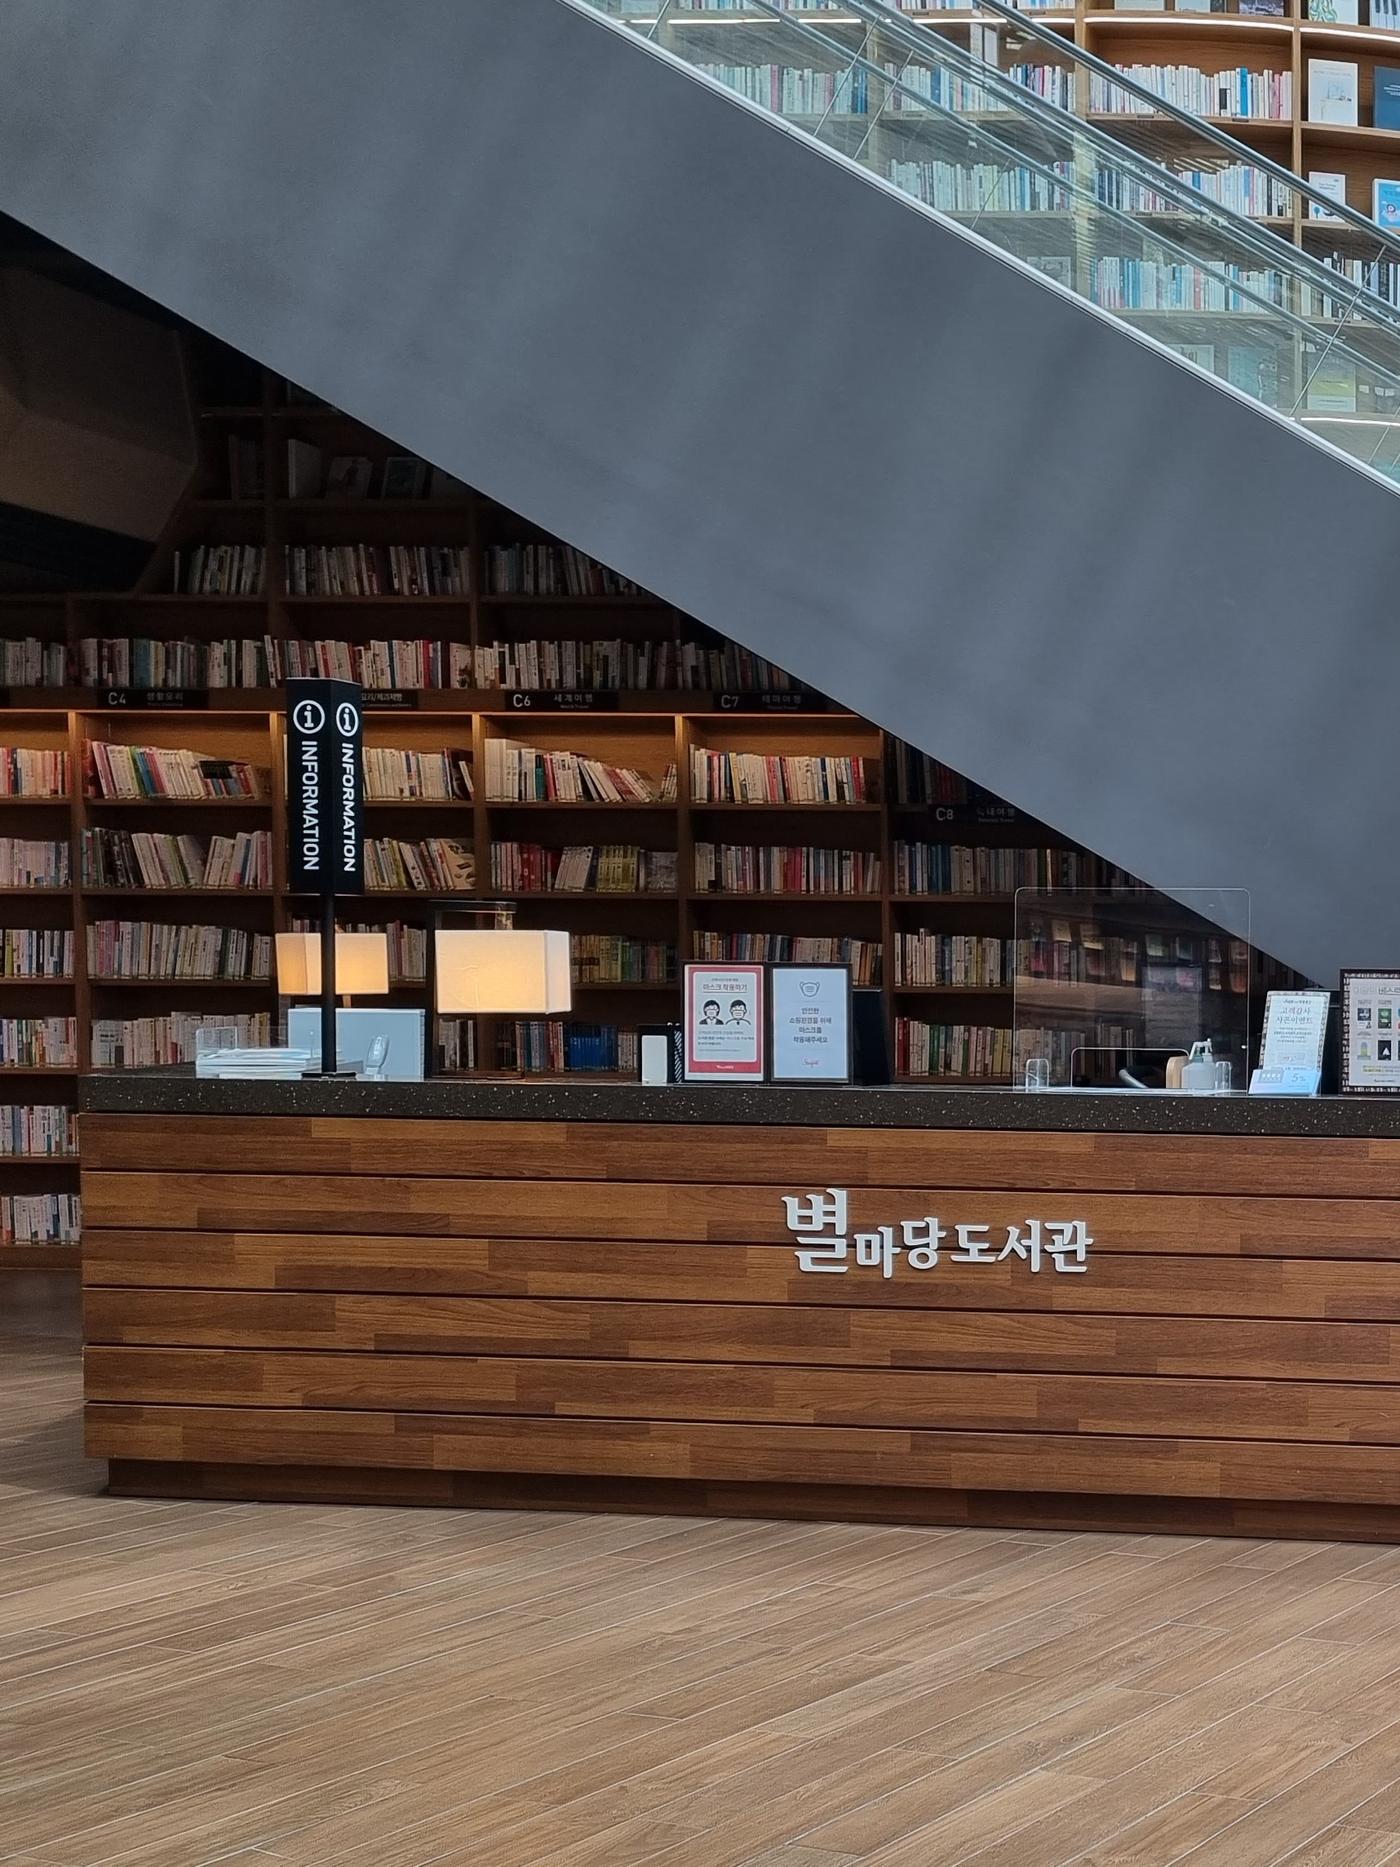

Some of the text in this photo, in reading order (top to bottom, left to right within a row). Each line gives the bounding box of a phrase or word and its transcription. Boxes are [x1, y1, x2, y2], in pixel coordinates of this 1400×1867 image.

[108, 692, 127, 706] C4
[512, 693, 531, 708] C6
[720, 694, 740, 709] C7
[301, 740, 320, 870] INFORMATION
[341, 742, 357, 872] INFORMATION
[935, 807, 954, 822] C8
[781, 1188, 1095, 1279] 별마당 도서관
